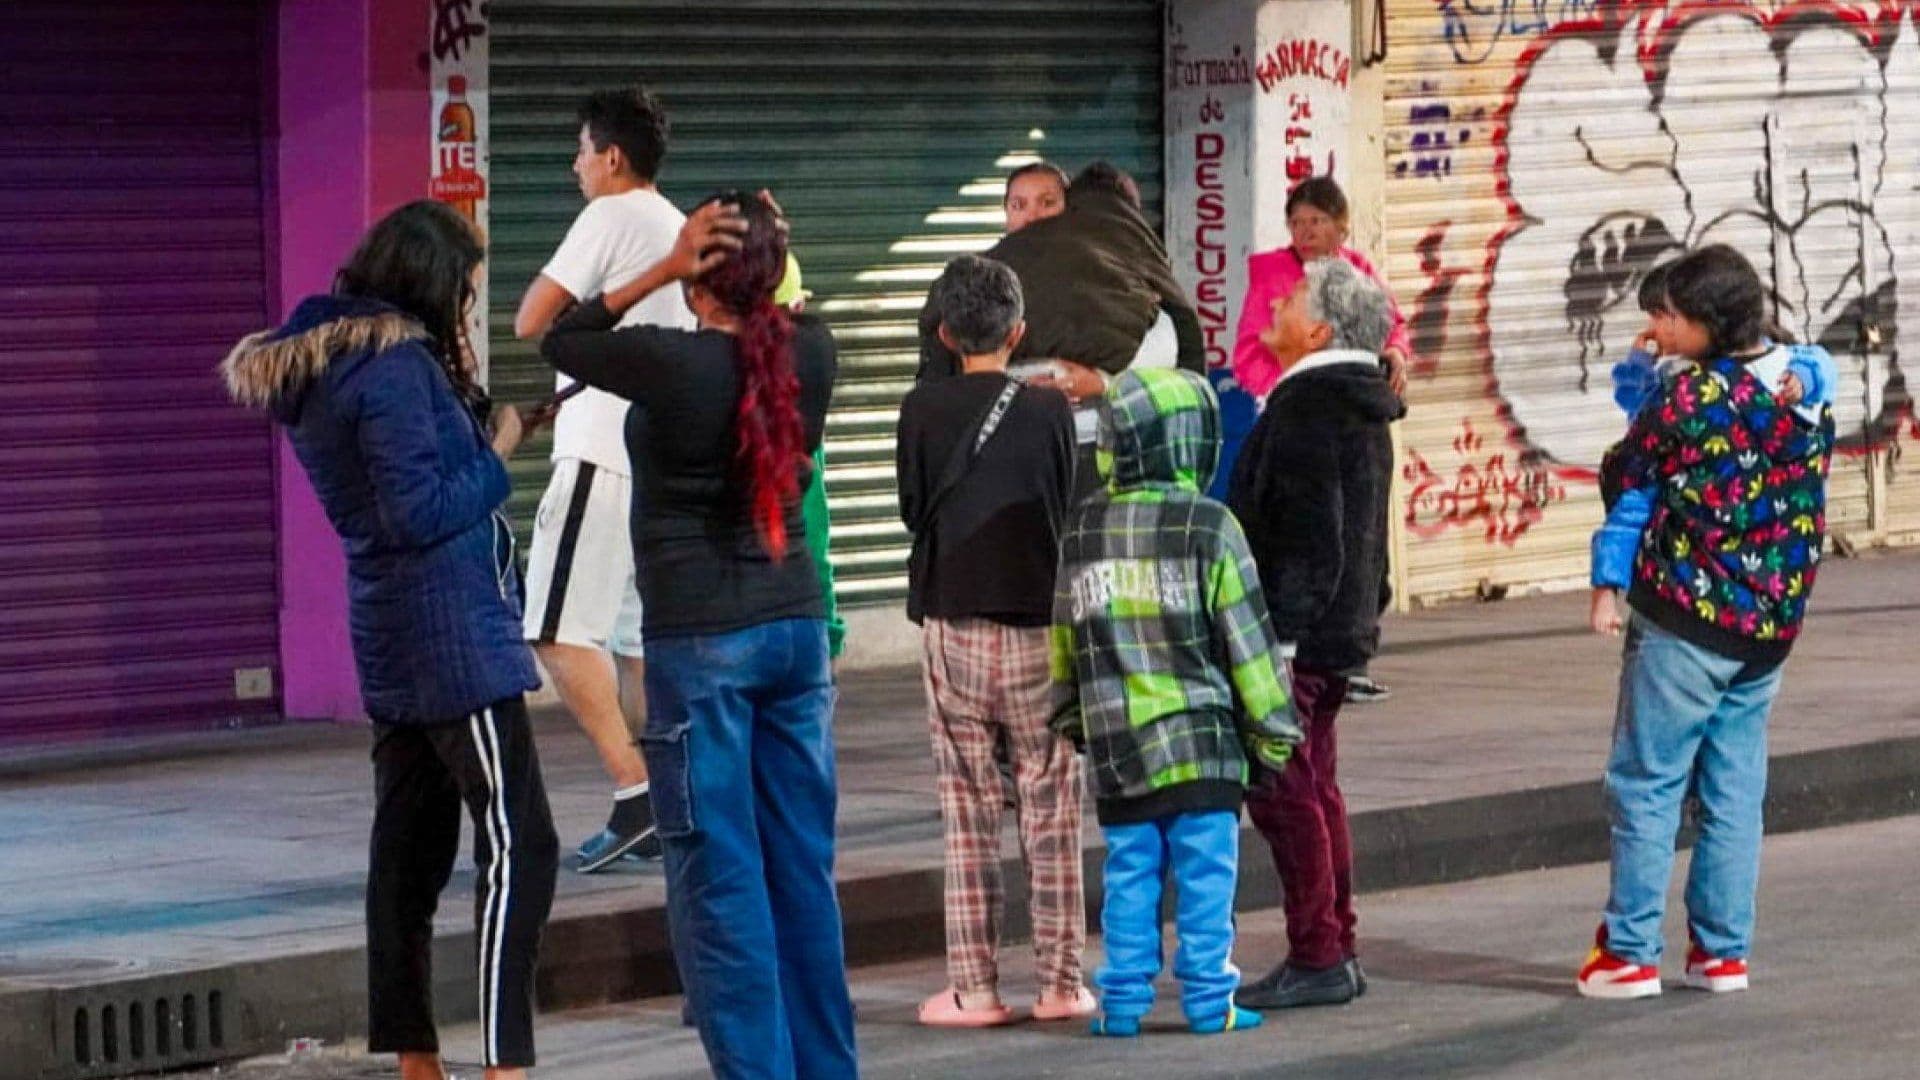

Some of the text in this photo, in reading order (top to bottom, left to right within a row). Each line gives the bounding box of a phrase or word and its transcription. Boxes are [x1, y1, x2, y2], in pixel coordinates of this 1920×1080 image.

[1168, 44, 1252, 91] Farmacia
[1256, 39, 1350, 93] FARMACIA
[1200, 97, 1225, 124] de
